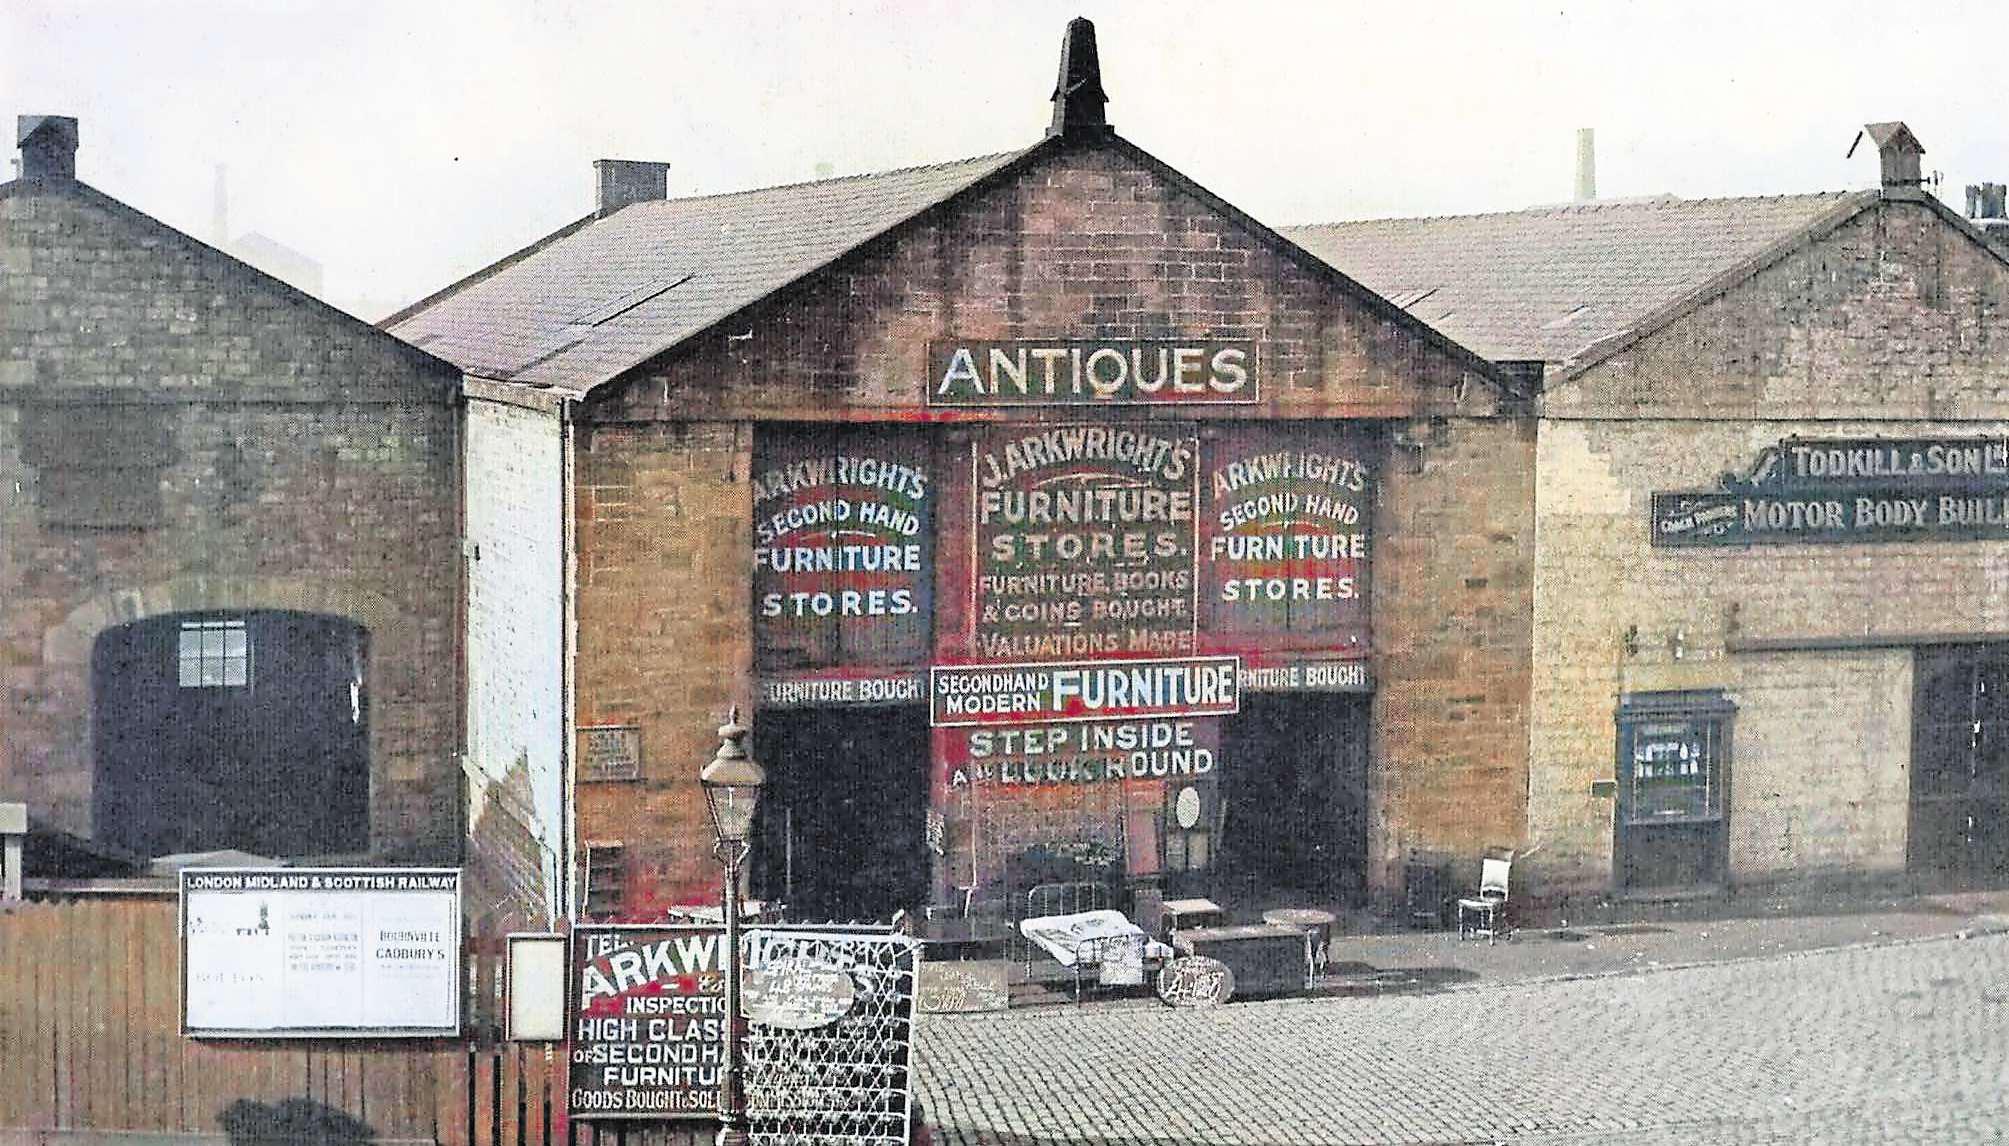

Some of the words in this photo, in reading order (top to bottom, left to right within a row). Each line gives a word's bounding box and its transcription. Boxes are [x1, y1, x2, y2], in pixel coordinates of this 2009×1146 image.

[937, 347, 1247, 399] ANTIQUES
[1792, 446, 1906, 477] TODKILL
[1927, 445, 1980, 475] SON
[981, 490, 1191, 525] FURNITURE
[1220, 492, 1298, 531] SECOND
[1305, 494, 1359, 525] HAND
[1744, 499, 1845, 531] MOTOR
[1856, 498, 1928, 528] BODY
[757, 500, 850, 545] SECOND
[859, 502, 920, 536] HAND
[754, 544, 921, 573] FURNITURE
[992, 532, 1188, 561] STORES.
[1211, 534, 1365, 561] FURNTURE
[1114, 570, 1190, 591] BOOKS
[1222, 578, 1360, 601] STORES.
[762, 589, 919, 617] STORES.
[1005, 601, 1082, 622] COINS
[980, 632, 1119, 658] VALUATIONS
[1130, 628, 1191, 652] MADE
[938, 672, 1049, 695] SECONDHAND
[1052, 665, 1233, 711] FURNITURE
[1239, 667, 1300, 687] RNITURE
[769, 680, 853, 702] URNITURE
[945, 691, 1041, 715] MODERN
[969, 726, 1068, 758] STEP
[1080, 722, 1194, 752] INSIDE
[187, 876, 242, 889] LONDON
[245, 876, 308, 889] MIDLAND
[311, 876, 321, 889] &
[324, 876, 395, 889] SCOTTISH
[398, 876, 456, 889] RAILWAY
[626, 996, 727, 1014] INSPECTIO
[578, 1018, 637, 1041] HIGH
[603, 1066, 725, 1086] FURNITU
[572, 1089, 625, 1109] GOODS
[626, 1087, 683, 1109] BOUGHT
